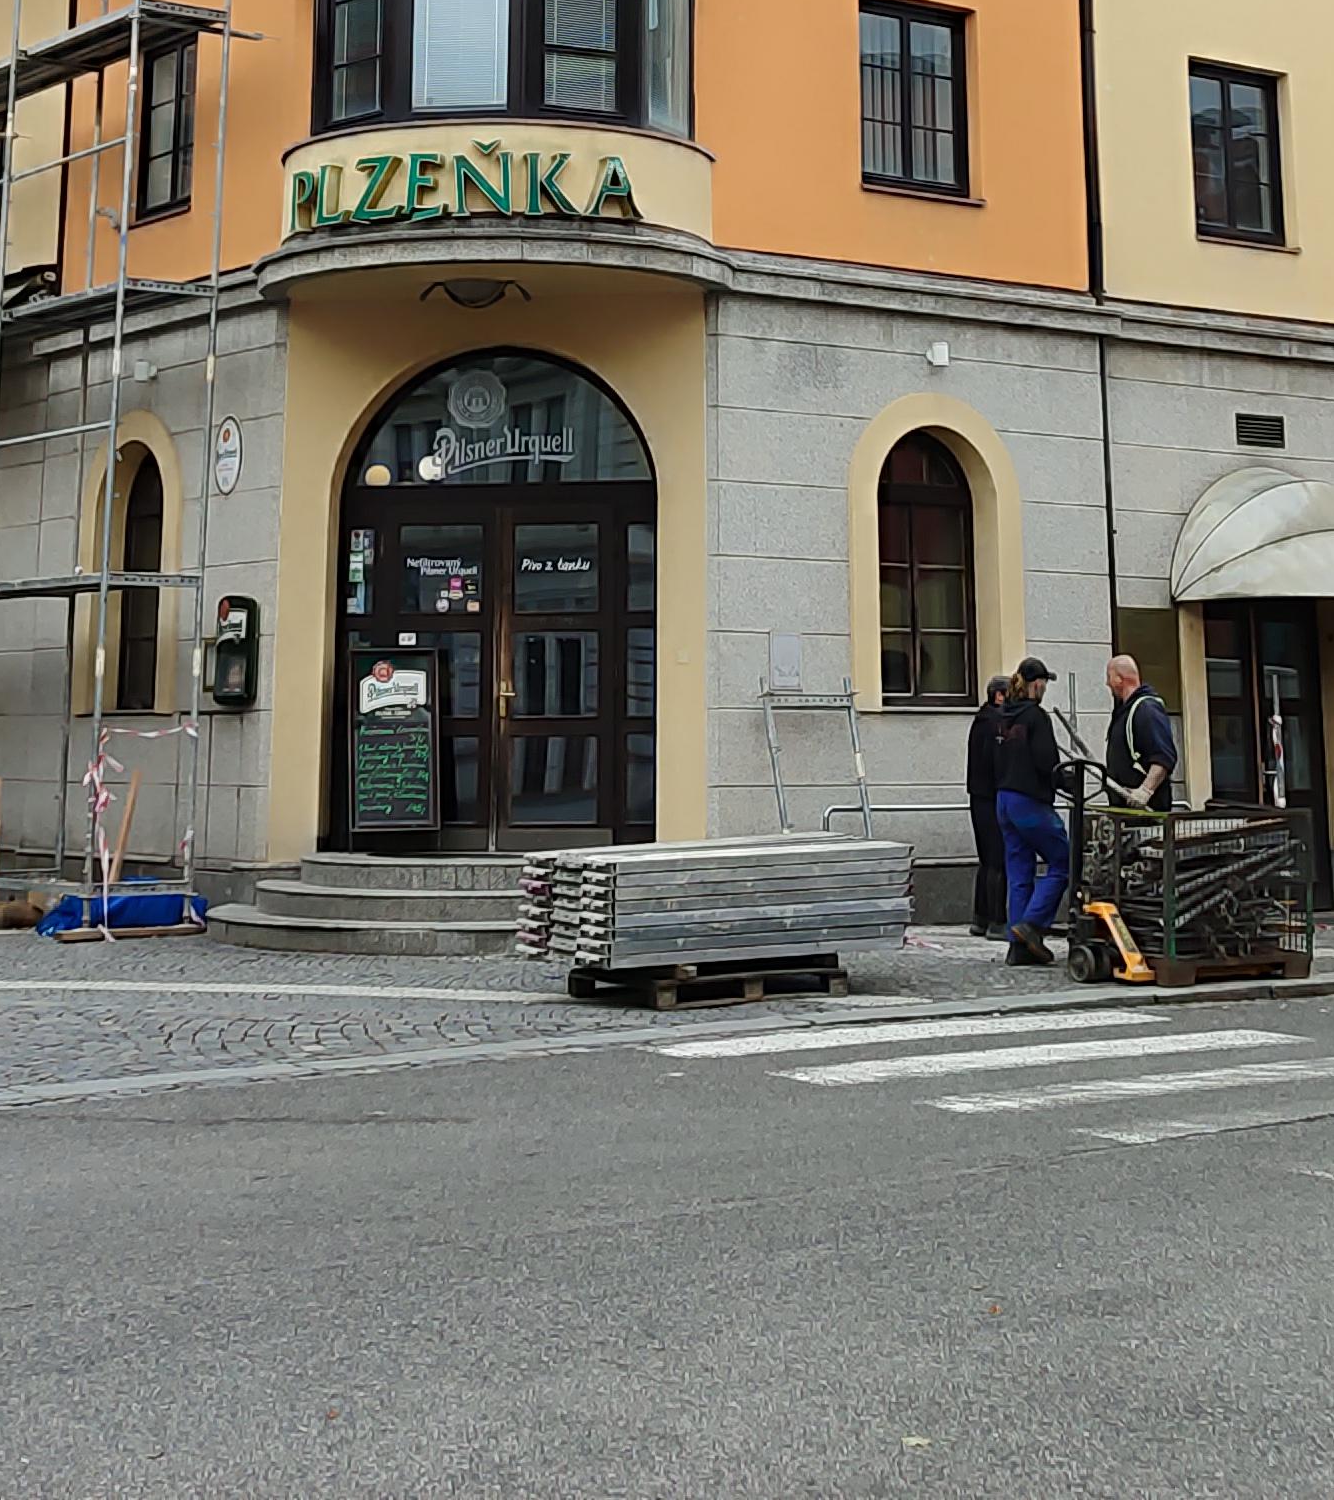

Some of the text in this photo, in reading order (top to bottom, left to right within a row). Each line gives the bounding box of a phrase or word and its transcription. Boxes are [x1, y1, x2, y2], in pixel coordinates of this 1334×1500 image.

[290, 139, 644, 233] PLZEŇKA
[433, 425, 573, 479] Pilsner Urquell
[521, 558, 542, 571] Pivo
[558, 557, 591, 571] tanku
